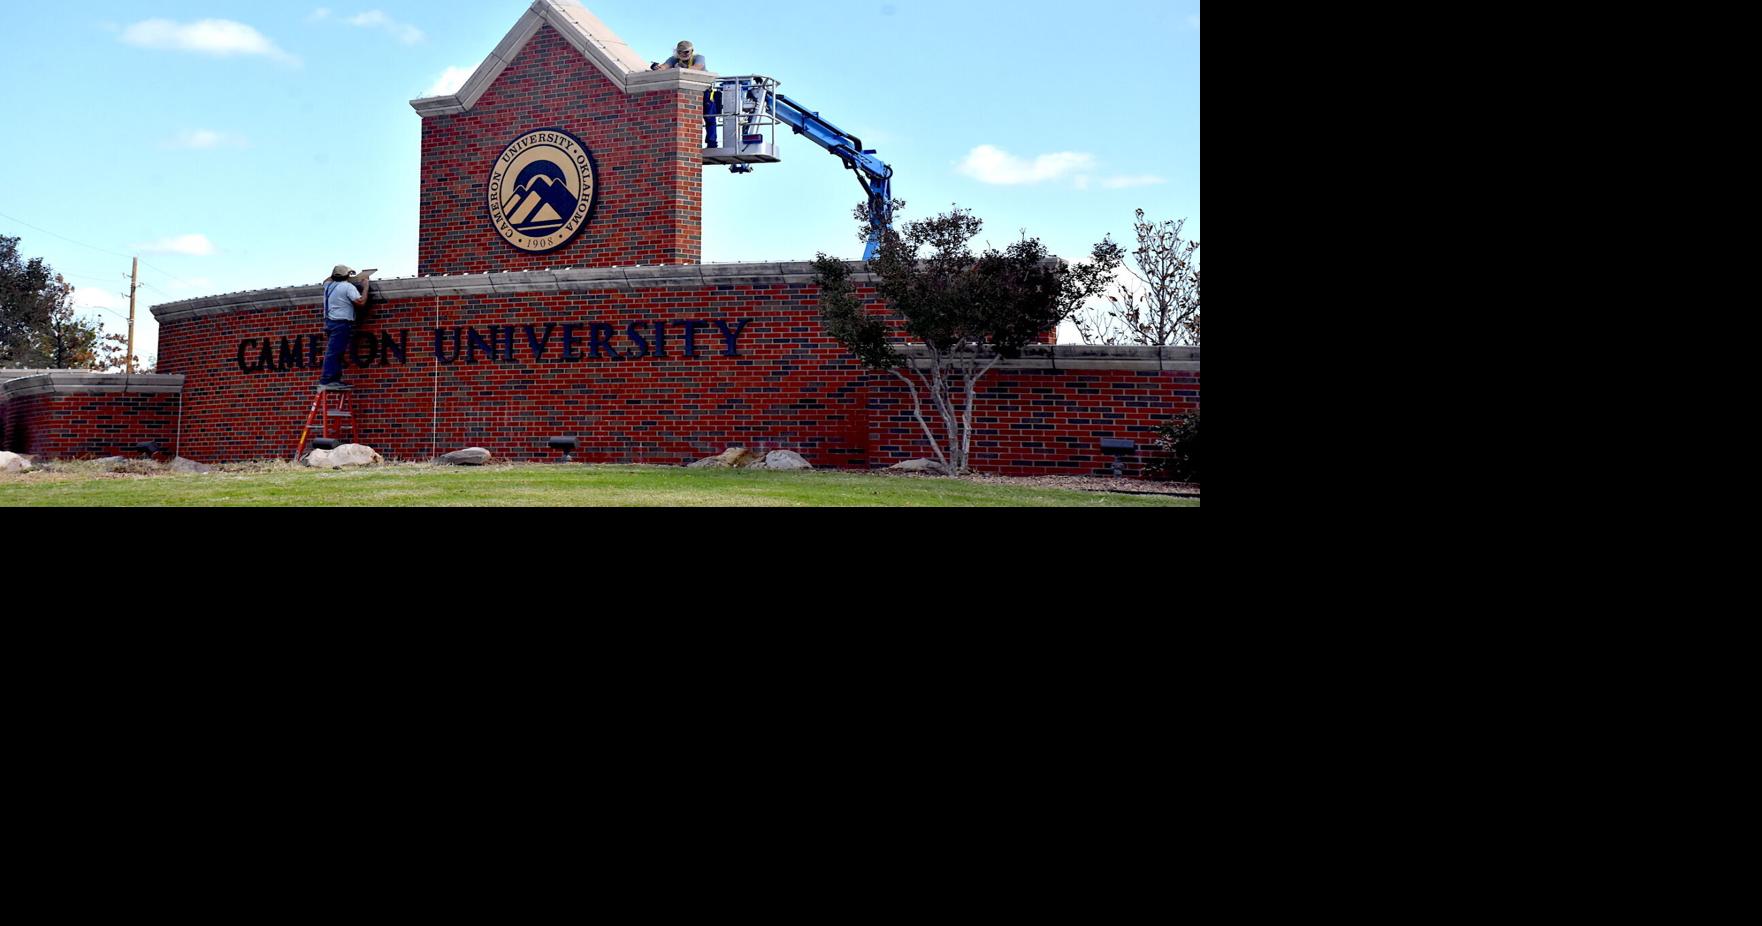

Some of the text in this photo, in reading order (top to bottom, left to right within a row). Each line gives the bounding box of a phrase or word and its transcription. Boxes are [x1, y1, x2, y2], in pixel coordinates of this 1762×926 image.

[490, 133, 591, 239] CAMERON UNIVERSITY OKLAHOMA
[526, 237, 554, 248] 1908
[237, 318, 750, 374] CAMEON UNIVERSITY
